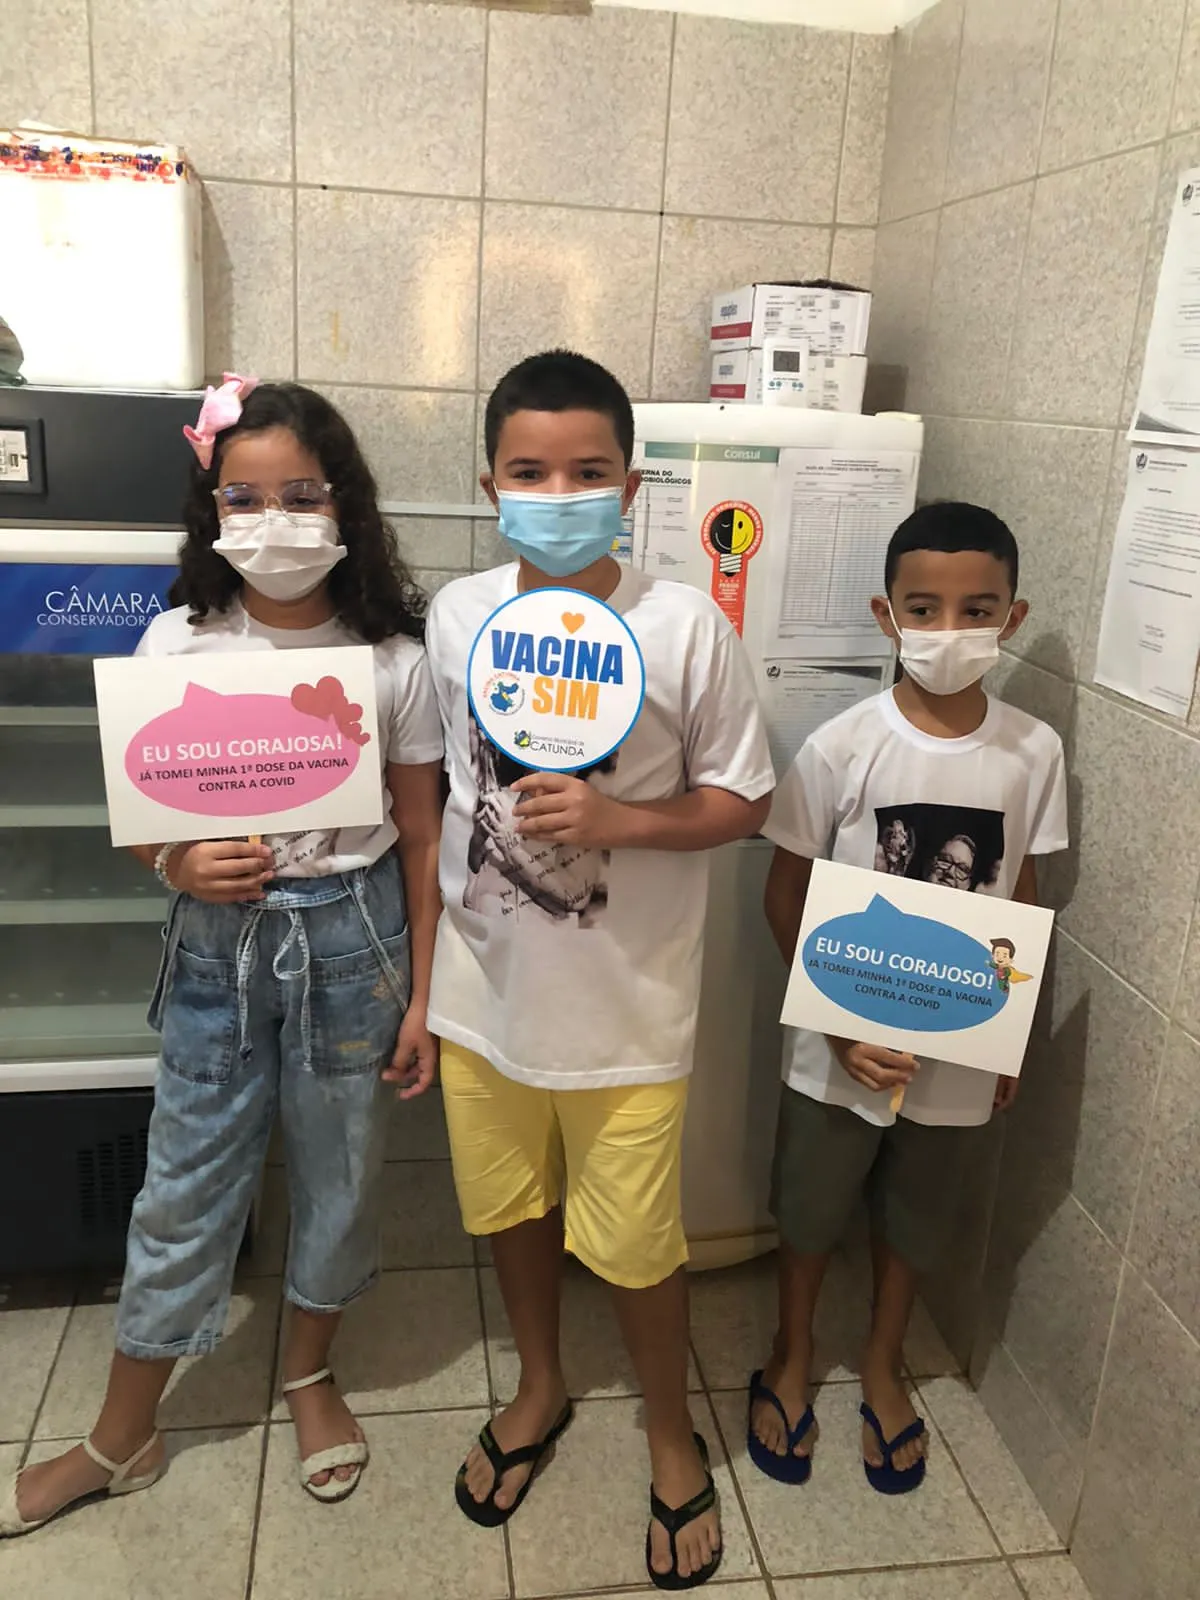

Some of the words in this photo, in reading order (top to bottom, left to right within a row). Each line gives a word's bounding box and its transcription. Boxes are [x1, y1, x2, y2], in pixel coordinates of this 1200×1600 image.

[724, 449, 761, 460] Consul
[45, 585, 163, 613] CÂMARA
[491, 629, 623, 685] VACINA
[532, 676, 600, 720] SIM
[143, 745, 170, 763] EU
[176, 741, 221, 761] SOU
[227, 733, 342, 757] CORAJOSA!
[530, 741, 585, 757] CATUNDA
[139, 770, 152, 782] JÁ
[156, 769, 193, 780] TOMEI
[196, 765, 237, 777] MINHA
[255, 762, 285, 773] DOSE
[288, 761, 304, 770] DA
[307, 758, 349, 769] VACINA
[198, 780, 246, 792] CONTRA
[249, 779, 257, 788] A
[260, 776, 295, 787] COVID
[815, 937, 840, 955] EU
[844, 943, 884, 965] SOU
[888, 953, 994, 990] CORAJOSO!
[823, 961, 855, 976] TOMEI
[856, 969, 893, 985] MINHA
[908, 980, 936, 994] DOSE
[937, 987, 952, 998] DA
[955, 991, 993, 1007] VACINA
[854, 983, 896, 1000] CONTRA
[898, 993, 906, 1003] A
[908, 995, 941, 1011] COVID
